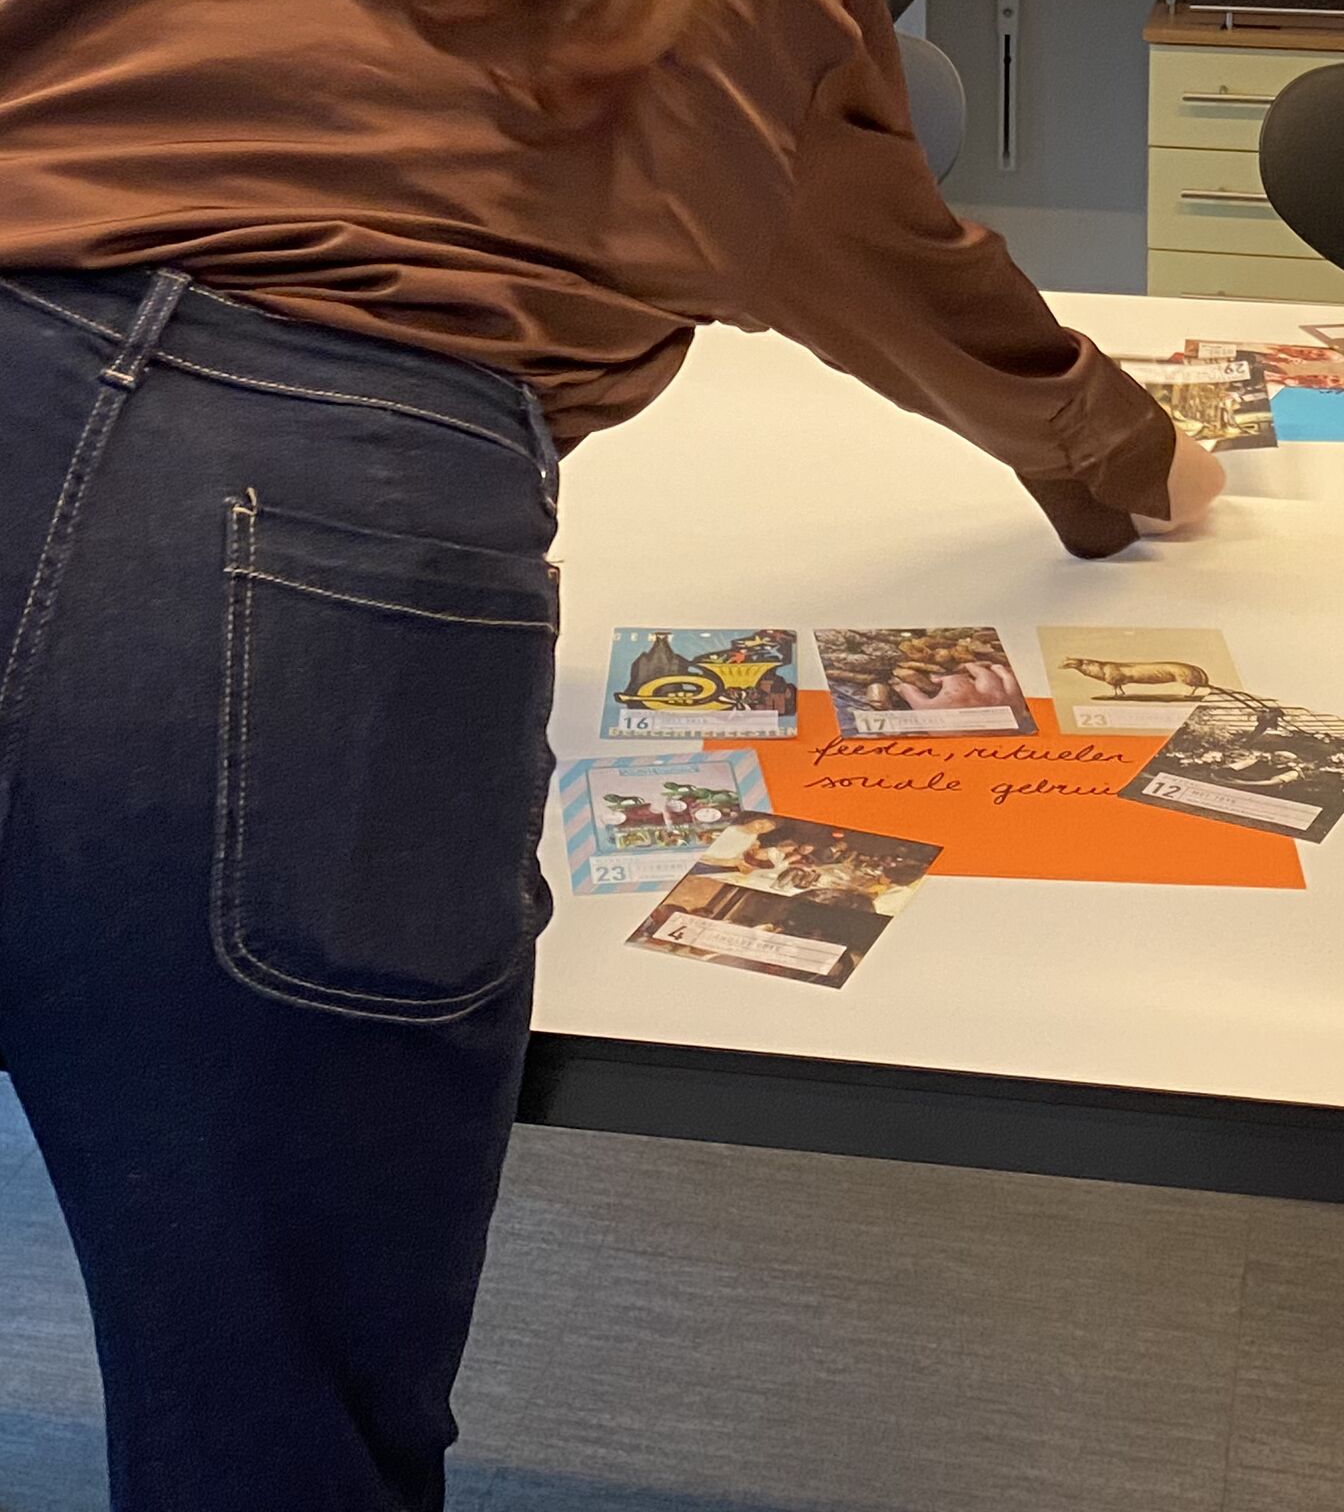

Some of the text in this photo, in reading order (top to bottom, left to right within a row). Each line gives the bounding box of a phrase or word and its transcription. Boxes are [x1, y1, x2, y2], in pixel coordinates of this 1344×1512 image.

[1224, 363, 1245, 375] 29
[623, 717, 650, 730] 16
[860, 717, 886, 731] 17
[1079, 713, 1109, 727] 23
[807, 736, 1135, 767] feesten, rituelen
[990, 778, 1120, 805] gebrui
[1151, 781, 1182, 799] 12
[596, 865, 627, 882] 23
[667, 925, 687, 941] 4
